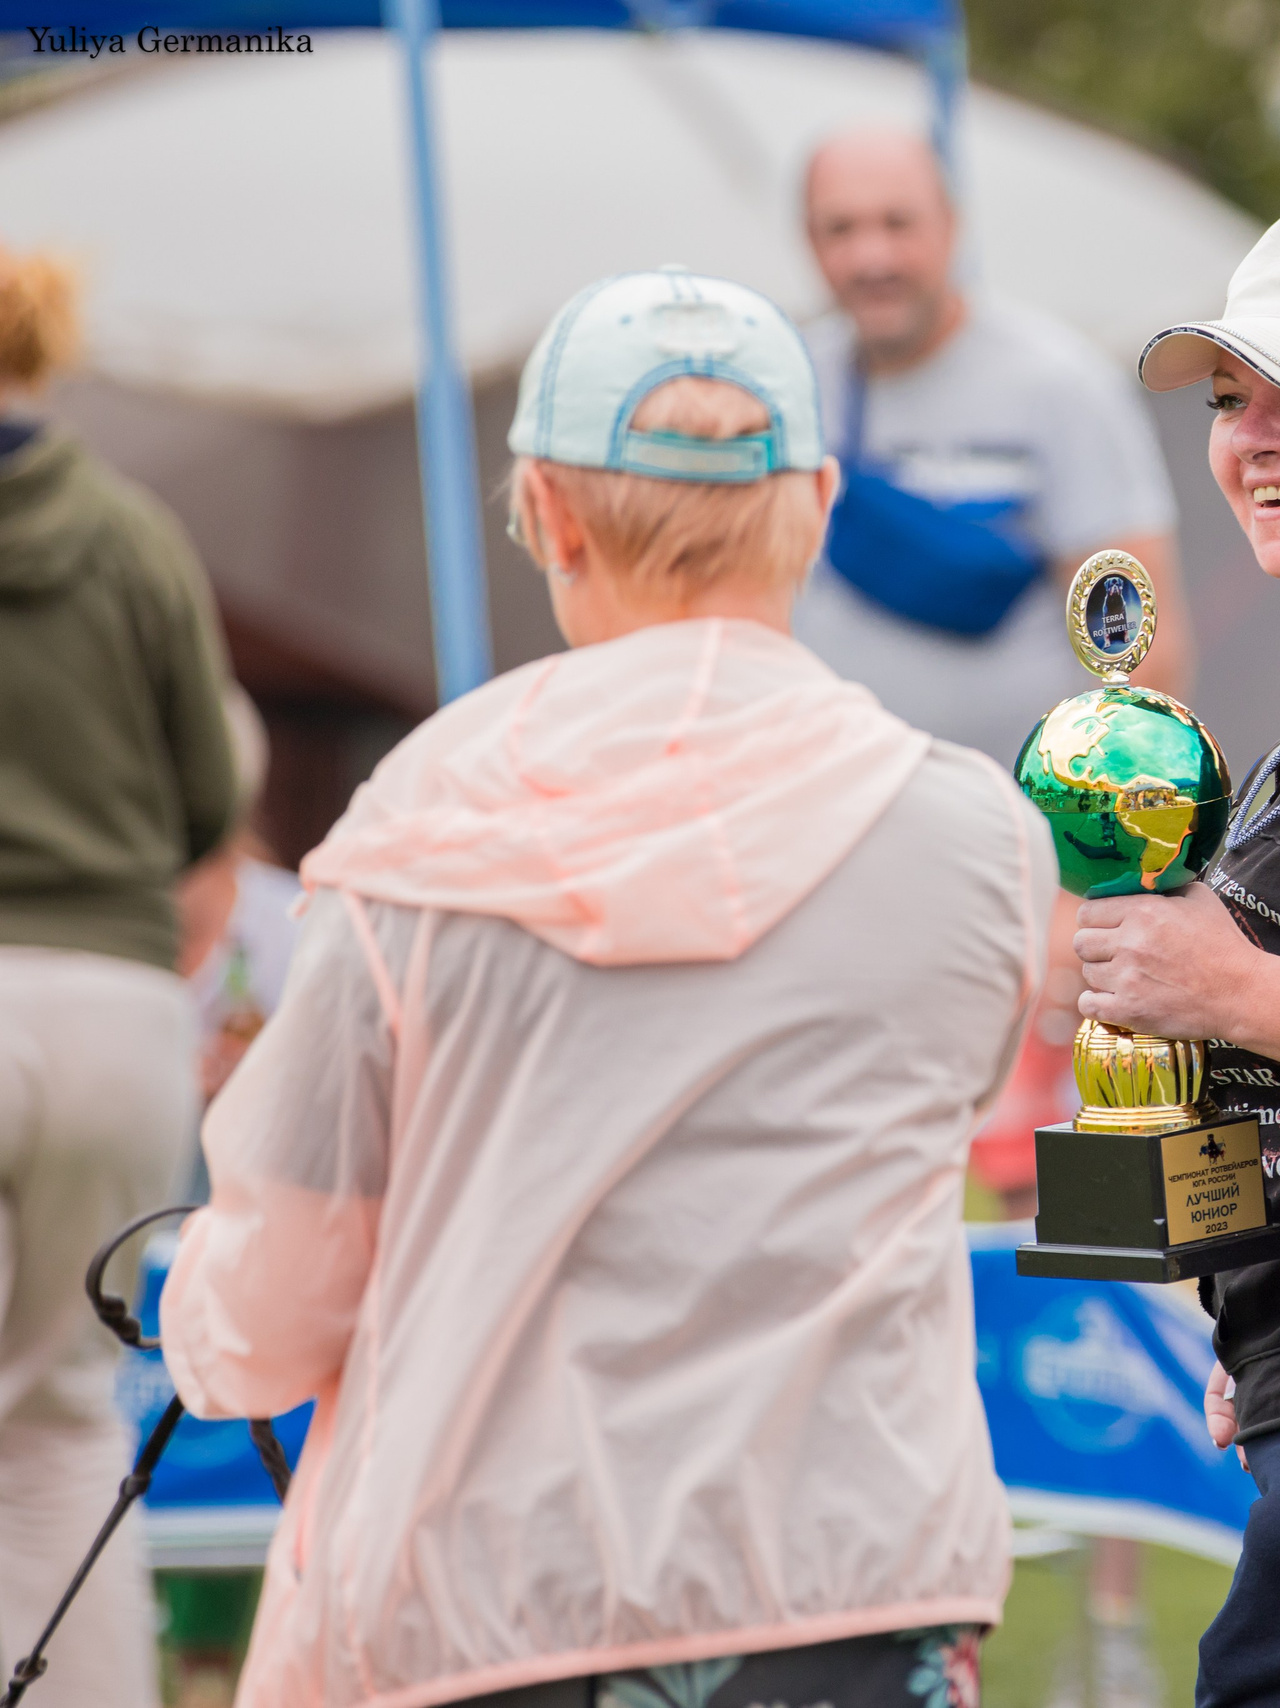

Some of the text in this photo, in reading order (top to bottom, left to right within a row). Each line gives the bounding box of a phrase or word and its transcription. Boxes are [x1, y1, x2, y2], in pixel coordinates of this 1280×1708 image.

[1101, 613, 1125, 624] TERRA
[1092, 621, 1137, 637] ROTTWEILER
[1168, 1158, 1259, 1183] ЧЕМПИОНАТ РОТВЕЙЛЕРОВ
[1192, 1172, 1236, 1188] ЮГА РОССИИ
[1186, 1182, 1240, 1207] ЛУЧШИЙ
[1191, 1202, 1238, 1223] ЮНИОР
[1205, 1221, 1228, 1234] 2023
